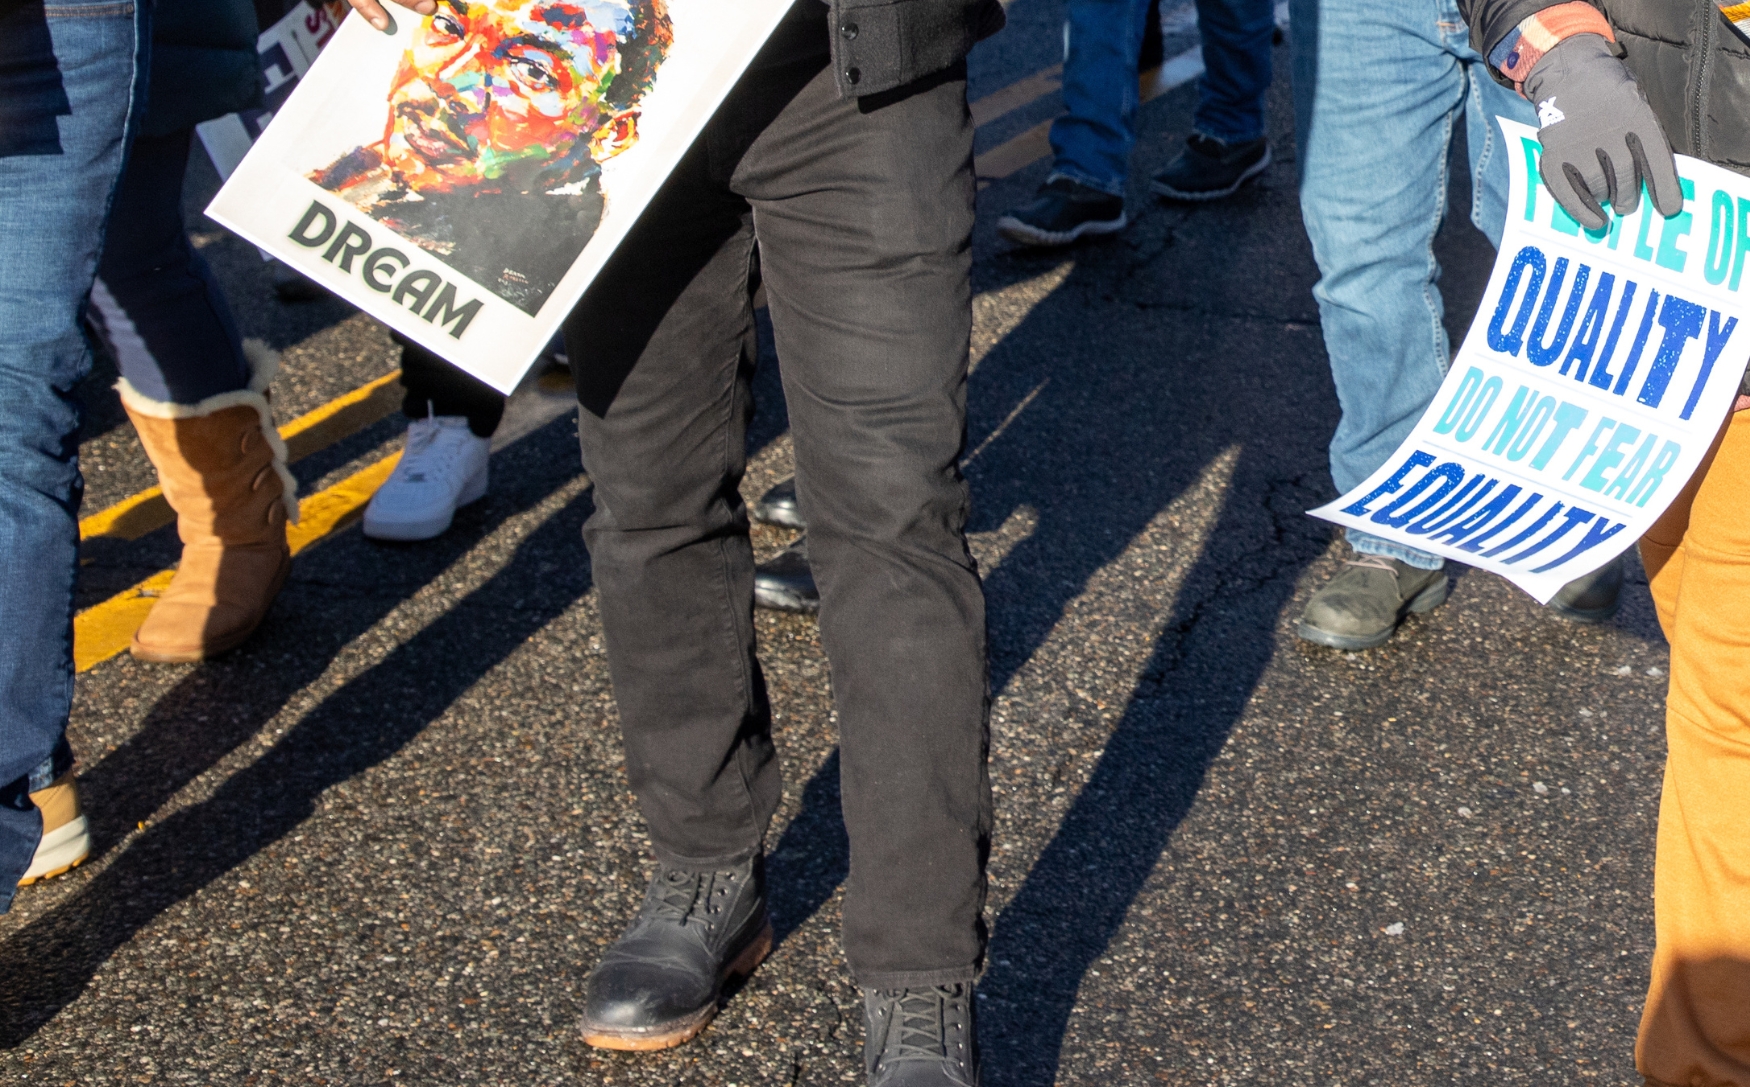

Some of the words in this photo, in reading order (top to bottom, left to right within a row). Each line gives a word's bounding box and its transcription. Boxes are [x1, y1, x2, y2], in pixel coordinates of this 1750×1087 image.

[286, 197, 485, 342] DREAM
[1519, 135, 1697, 272] PLE
[1486, 245, 1739, 421] QUALITY
[1432, 365, 1504, 444] DO
[1481, 382, 1588, 472] NOT
[1562, 415, 1683, 509] FEAR
[1340, 448, 1627, 575] EQUALITY
